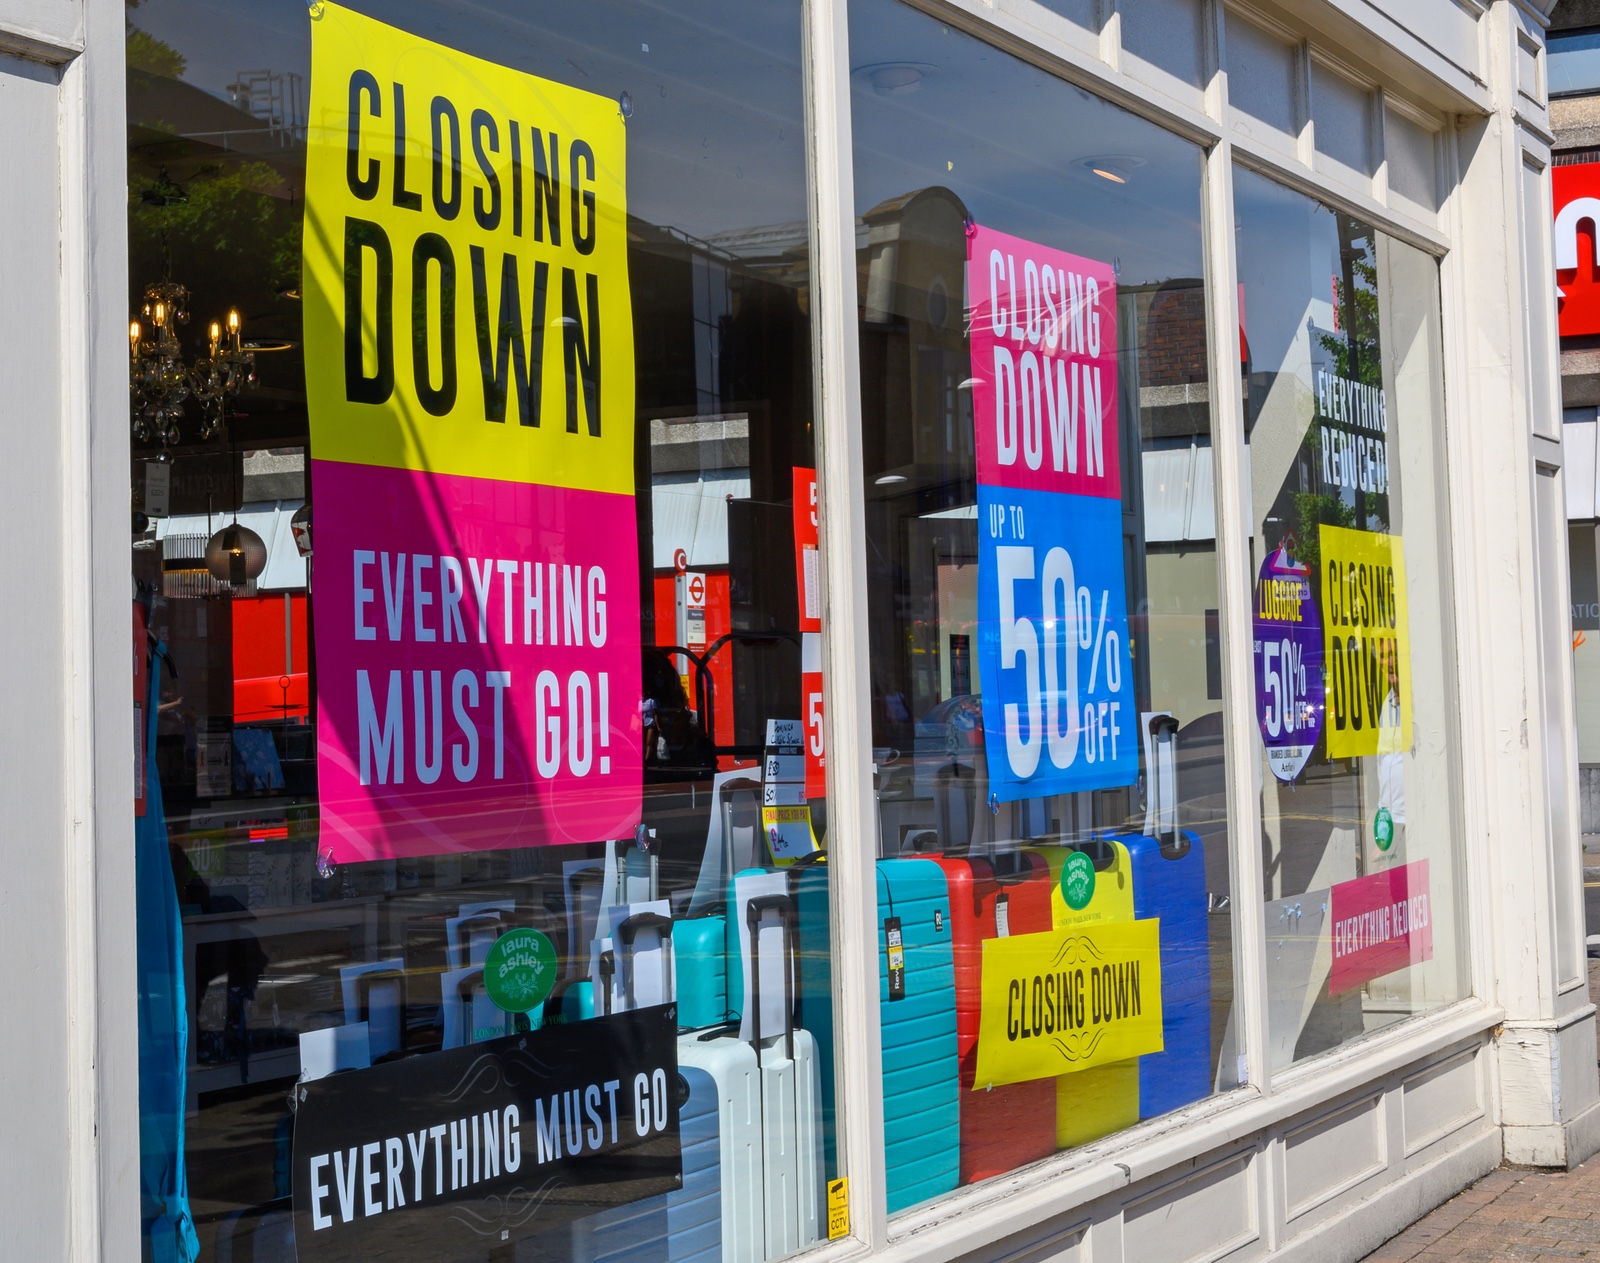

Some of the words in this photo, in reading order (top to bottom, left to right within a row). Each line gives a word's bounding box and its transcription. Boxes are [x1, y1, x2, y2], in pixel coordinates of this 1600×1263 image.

[346, 69, 596, 256] CLOSING
[345, 216, 601, 438] DOWN
[990, 249, 1100, 359] CLOSING
[994, 346, 1104, 478] DOWN
[1318, 370, 1388, 434] EVERYTHING
[989, 503, 1005, 538] UP
[1009, 505, 1025, 540] TO
[353, 549, 608, 648] EVERYTHING
[1259, 579, 1303, 622] LUGGAGE
[1329, 559, 1397, 630] CLOSING
[996, 545, 1121, 778] 50%
[1264, 638, 1307, 738] 50%
[356, 669, 512, 786] MUST
[535, 670, 610, 778] GO!
[1085, 702, 1120, 764] OFF
[1067, 858, 1087, 872] laura
[1067, 869, 1089, 887] ashley
[501, 936, 540, 957] laura
[1335, 906, 1390, 958] EVERYTHING
[1392, 894, 1428, 937] REDUCED
[499, 952, 544, 978] ashley
[474, 1026, 506, 1040] LONDON
[530, 1016, 548, 1029] NEW
[548, 1012, 569, 1025] YORK
[1007, 968, 1085, 1042] CLOSING
[1091, 960, 1142, 1026] DOWN
[309, 1104, 521, 1230] EVERYTHING
[536, 1079, 620, 1164] MUST
[634, 1068, 668, 1137] GO
[831, 1216, 847, 1230] CCTV
